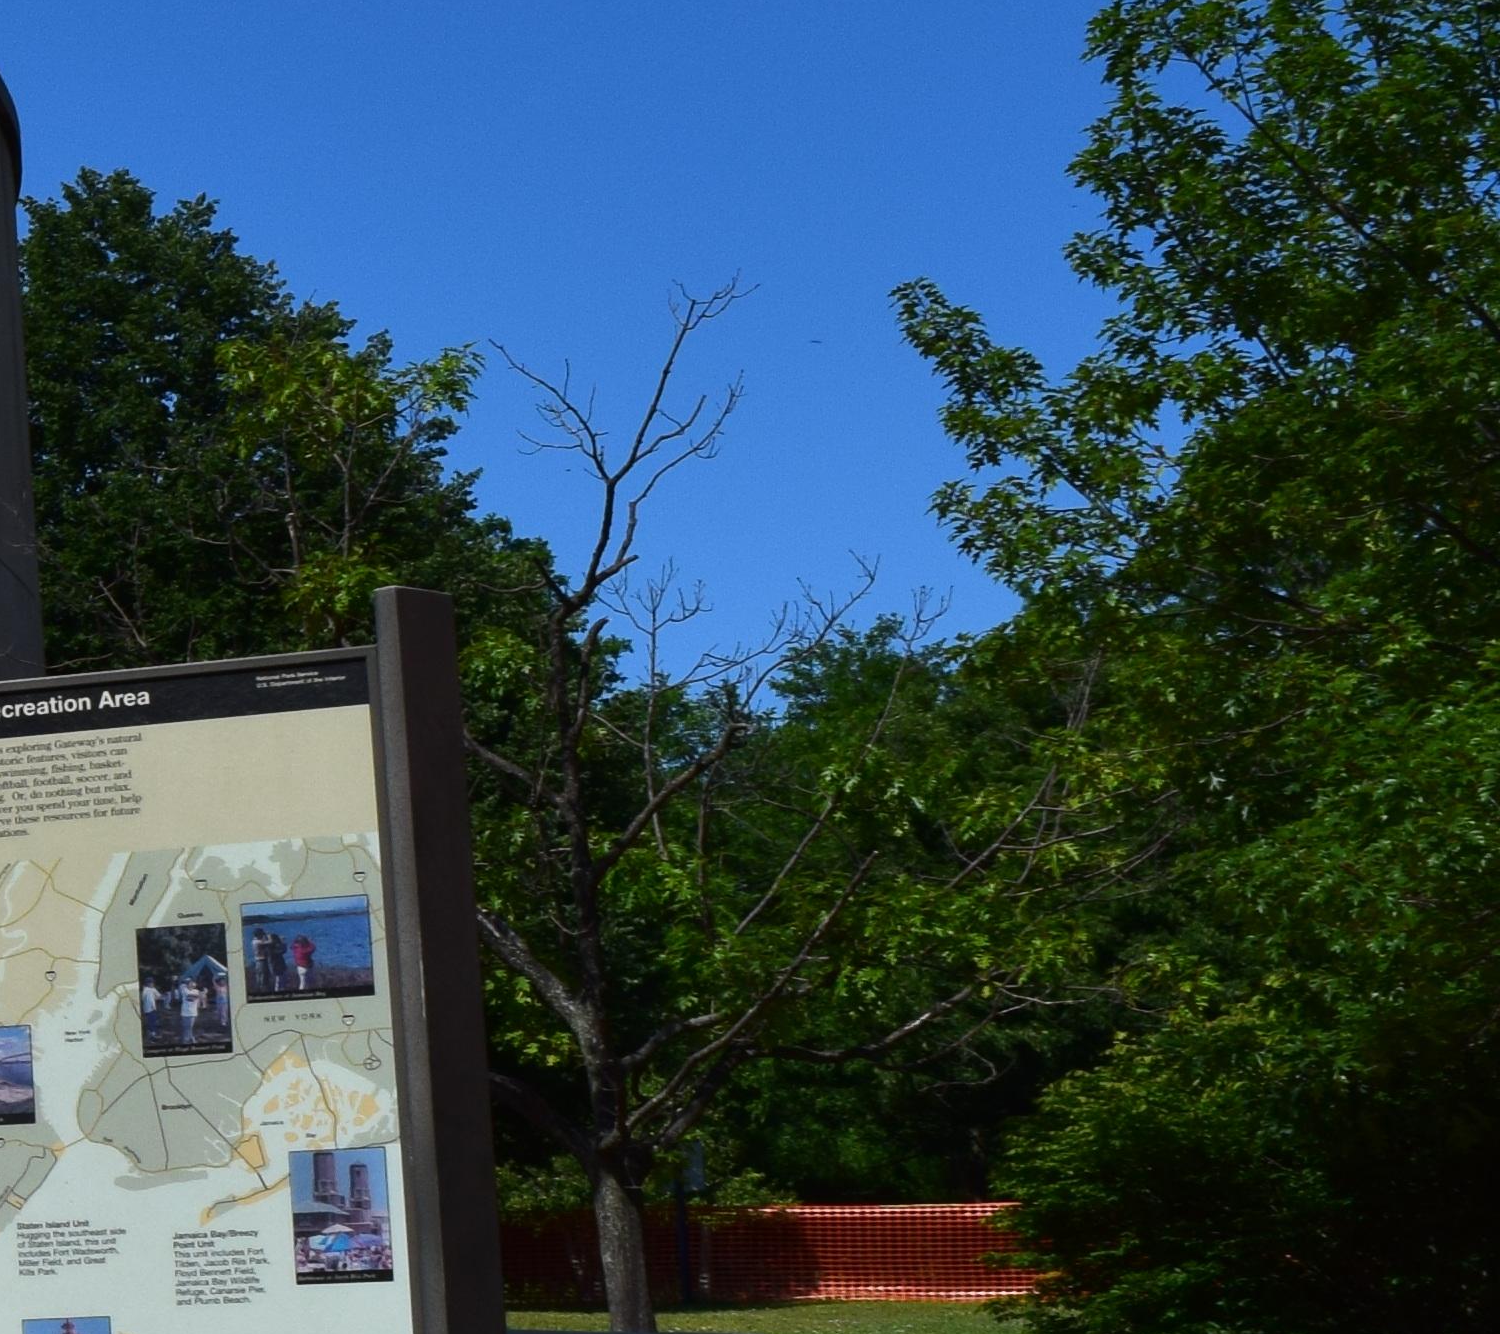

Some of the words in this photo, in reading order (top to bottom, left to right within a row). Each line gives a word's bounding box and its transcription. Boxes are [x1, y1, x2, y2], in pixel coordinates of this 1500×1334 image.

[98, 692, 150, 709] Area
[177, 911, 203, 919] Queens
[263, 1014, 286, 1023] NEW
[295, 1012, 323, 1021] YORK
